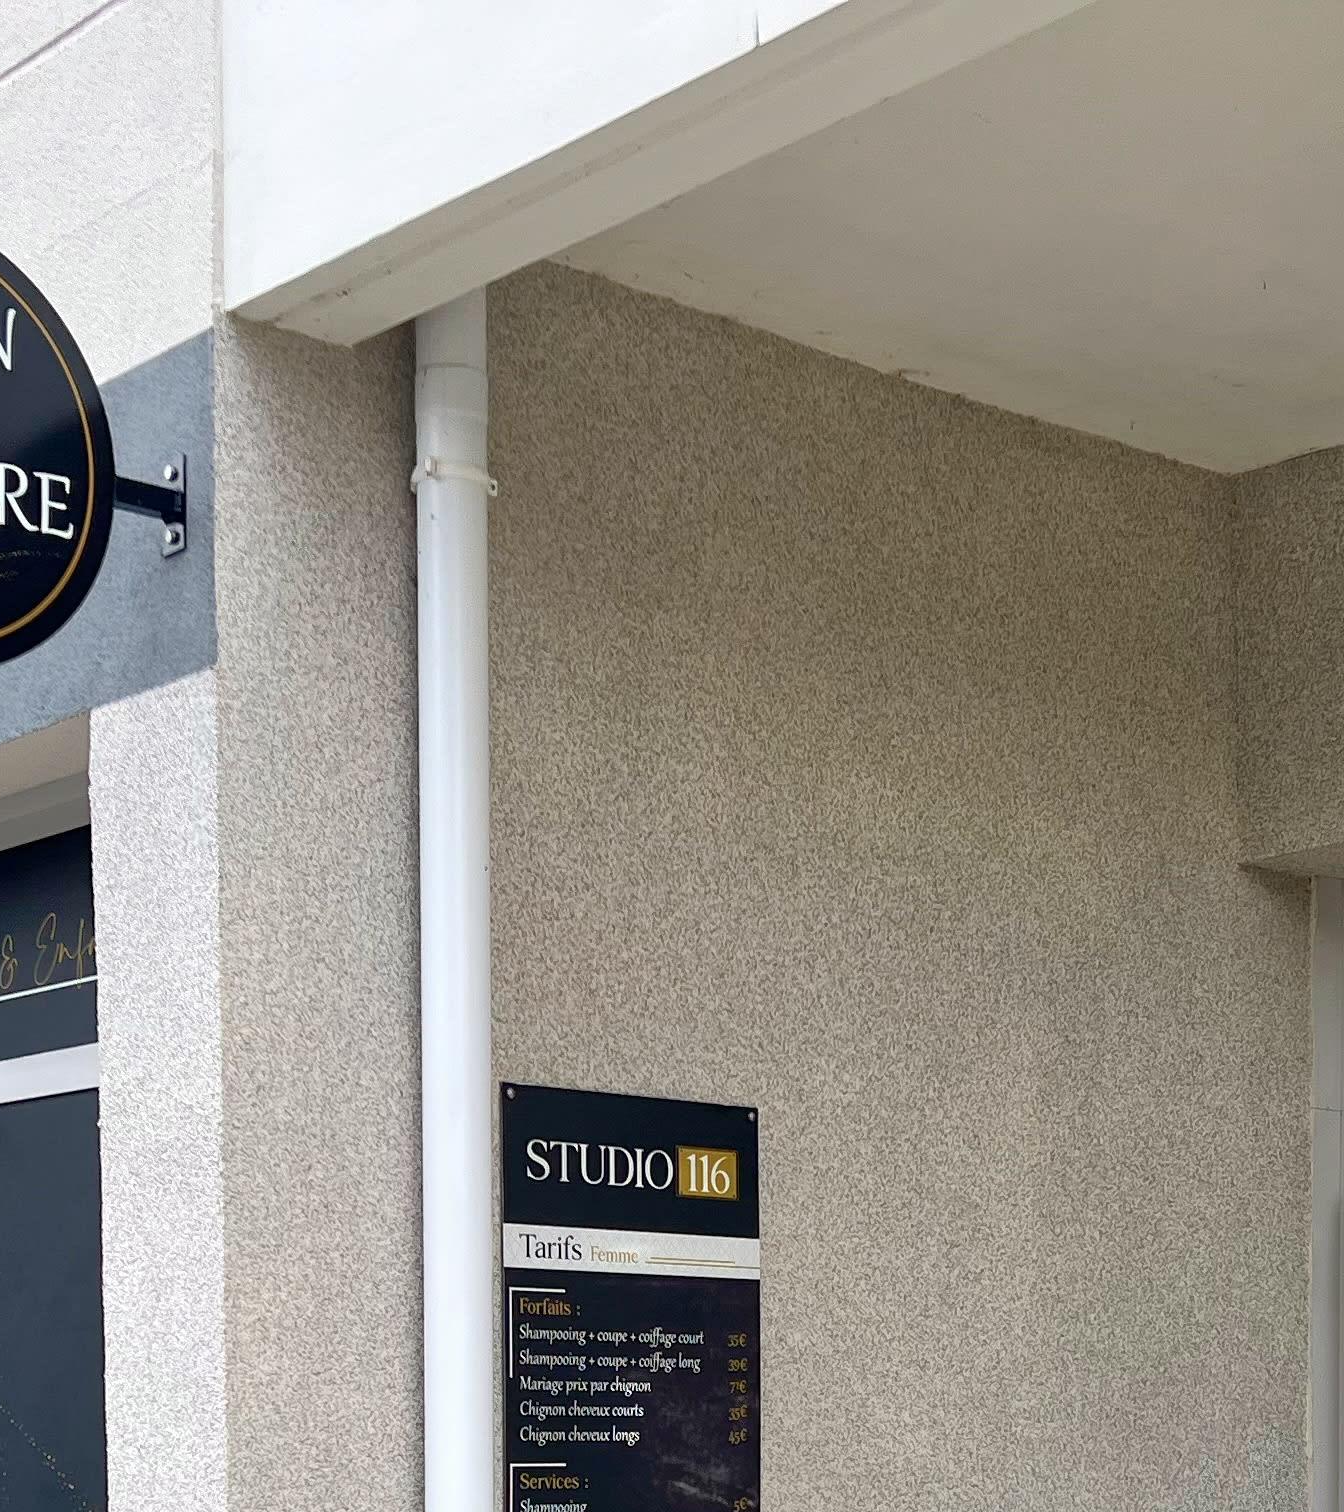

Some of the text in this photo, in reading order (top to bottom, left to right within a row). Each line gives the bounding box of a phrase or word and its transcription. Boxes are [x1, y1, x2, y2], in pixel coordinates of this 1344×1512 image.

[0, 934, 17, 989] &
[526, 1139, 731, 1194] STUDIO 116
[519, 1233, 639, 1265] Tarifs Femme
[519, 1297, 572, 1316] Forfaits
[519, 1323, 705, 1348] Shampooing coupe coiffage court
[519, 1348, 701, 1374] Shampooing coupe coiffage long
[520, 1376, 652, 1397] Mariage prix par chignon
[520, 1400, 644, 1421] Chignon cheveux courts
[520, 1425, 640, 1447] Chignon cheveux longs
[520, 1473, 580, 1490] Services
